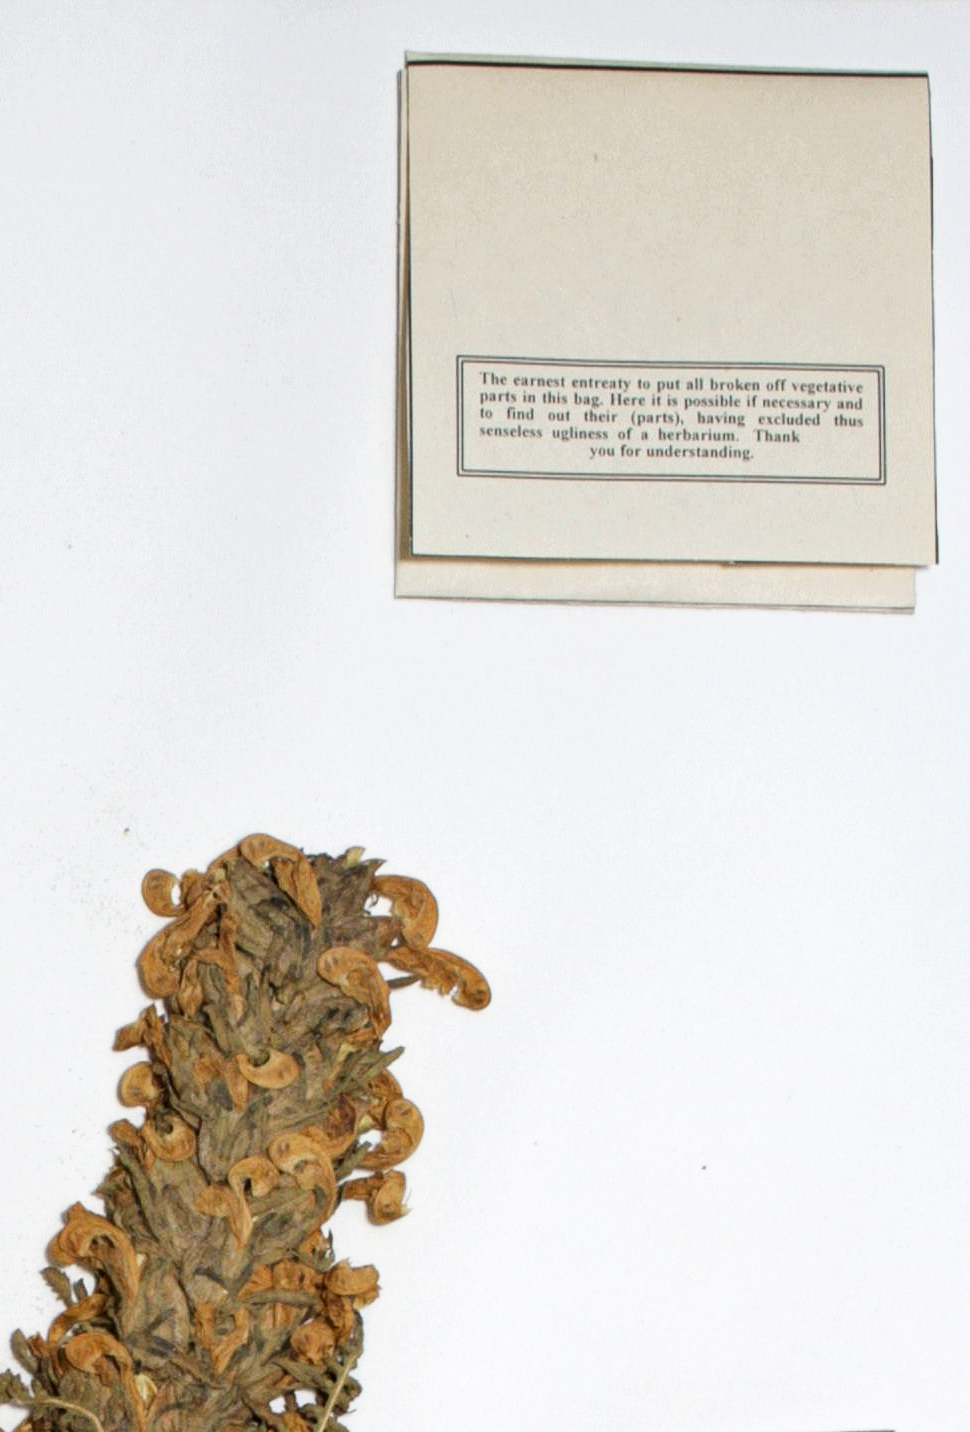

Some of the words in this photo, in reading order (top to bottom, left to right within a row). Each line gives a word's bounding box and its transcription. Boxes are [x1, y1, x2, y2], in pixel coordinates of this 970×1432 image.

[480, 372, 507, 385] The
[513, 377, 564, 387] earnest
[572, 378, 630, 392] entreaty
[638, 379, 650, 389] to
[657, 380, 680, 393] put
[686, 378, 703, 390] all
[710, 378, 760, 391] broken
[766, 379, 786, 391] off
[792, 381, 863, 395] vegetative
[480, 392, 516, 405] parts
[523, 391, 536, 403] in
[543, 392, 567, 404] this
[574, 392, 603, 407] bag.
[611, 393, 645, 406] Here
[652, 394, 661, 406] it
[667, 395, 678, 407] is
[684, 395, 740, 410] possible
[747, 395, 757, 407] if
[763, 399, 830, 412] necessary
[837, 398, 862, 410] and
[480, 408, 492, 419] to
[507, 407, 534, 420] find
[548, 411, 570, 421] out
[584, 410, 617, 422] their
[631, 411, 684, 426] (parts),
[697, 411, 745, 427] having
[758, 413, 820, 426] excluded
[834, 414, 863, 427] thus
[480, 425, 542, 438] senseless
[552, 426, 608, 442] ugliness
[618, 427, 633, 440] of
[641, 432, 648, 440] a
[659, 428, 739, 441] herbarium.
[753, 429, 800, 443] Thank
[590, 448, 615, 459] you
[621, 445, 641, 457] for
[647, 445, 753, 461] understanding.
